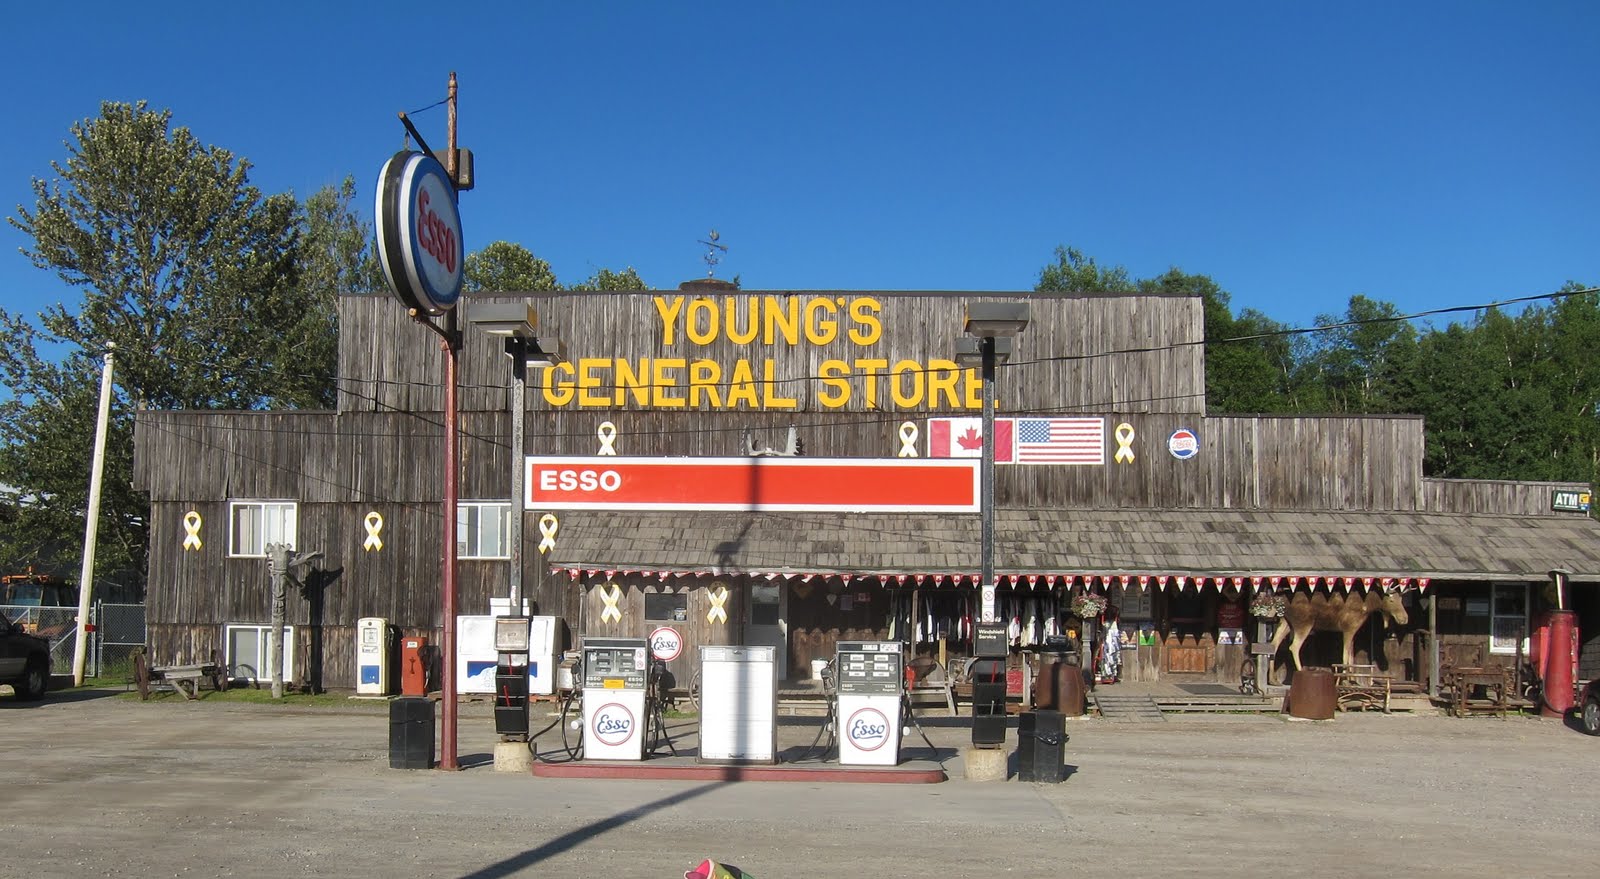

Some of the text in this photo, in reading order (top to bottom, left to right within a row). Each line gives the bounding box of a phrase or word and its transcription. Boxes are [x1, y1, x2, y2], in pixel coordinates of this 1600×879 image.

[654, 296, 882, 346] YOUNG'S
[542, 357, 999, 409] GENERAL STORE
[540, 469, 622, 492] ESSO
[1555, 492, 1578, 506] ATM
[653, 636, 678, 651] Esso
[597, 714, 630, 734] Esso
[851, 719, 885, 739] Esso
